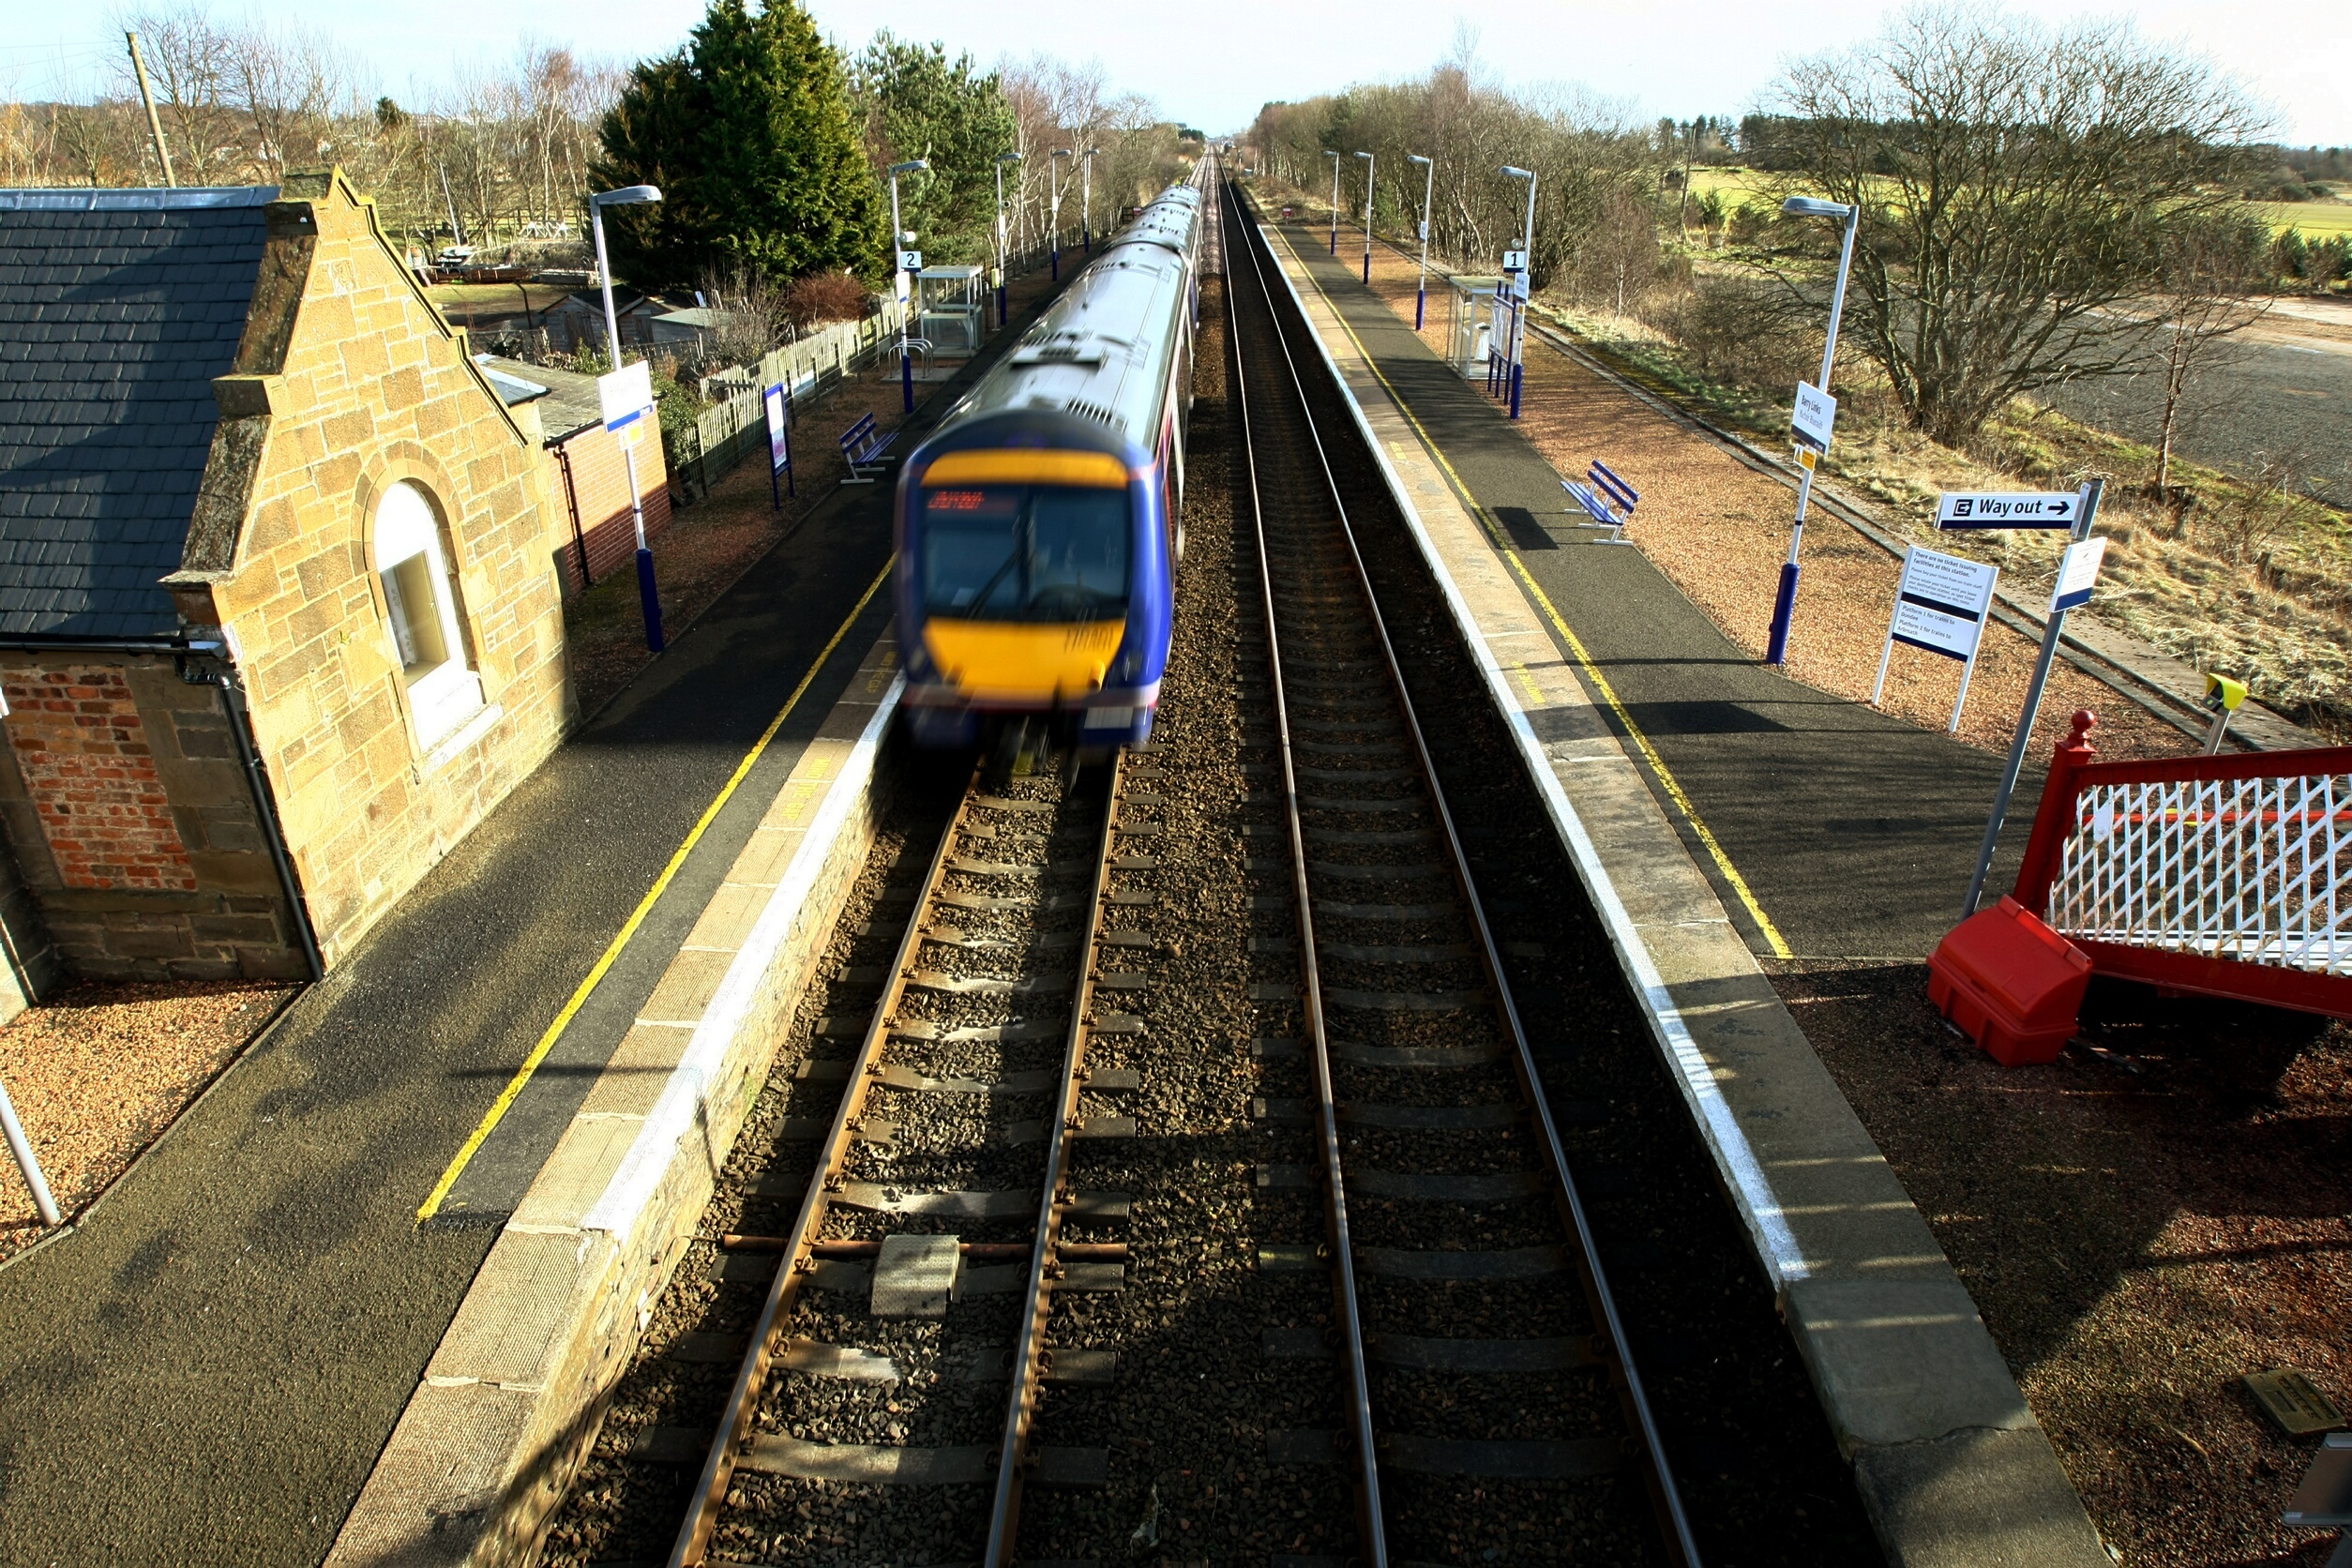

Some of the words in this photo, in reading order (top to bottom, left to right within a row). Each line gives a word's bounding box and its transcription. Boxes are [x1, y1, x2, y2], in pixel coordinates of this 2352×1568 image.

[906, 252, 915, 266] 2
[1511, 252, 1518, 267] 1
[1801, 395, 1811, 411] Barry
[1811, 400, 1821, 415] Links
[1979, 499, 2012, 517] Way
[2014, 500, 2042, 513] out
[1913, 558, 1934, 568] facilities
[1951, 568, 1970, 577] station.
[1959, 563, 1977, 573] issuing
[1901, 612, 1918, 621] Dundee
[1903, 605, 1922, 615] Platform
[1934, 615, 1949, 623] trains
[1898, 626, 1918, 635] Arbroath
[1899, 620, 1919, 629] Platform
[1931, 629, 1945, 637] trains
